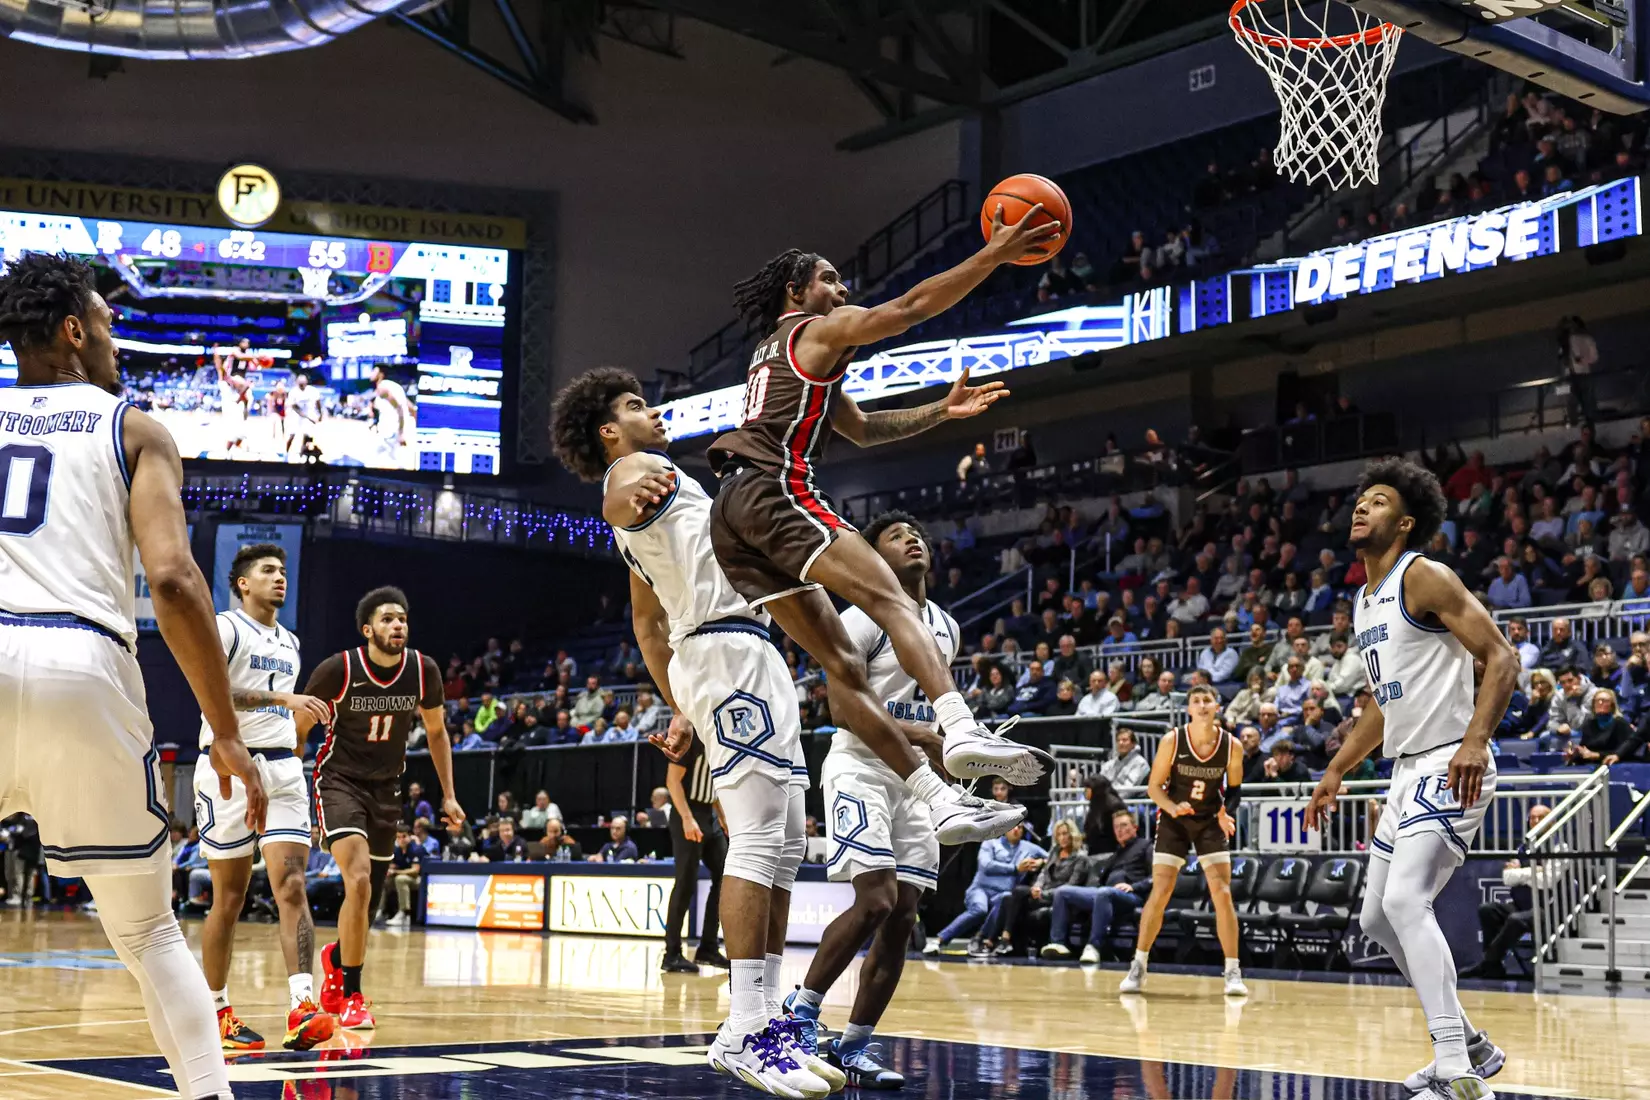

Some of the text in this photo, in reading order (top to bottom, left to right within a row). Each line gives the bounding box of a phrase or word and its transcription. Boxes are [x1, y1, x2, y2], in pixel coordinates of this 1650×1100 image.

[26, 184, 213, 219] UNIVERSITY
[141, 228, 182, 258] 48
[420, 219, 505, 241] ISLAND
[218, 238, 266, 261] 6:42
[308, 240, 347, 269] 55
[367, 242, 394, 274] B
[1294, 205, 1542, 303] DEFENSE
[250, 655, 293, 676] RHODE
[1365, 648, 1381, 685] 10
[350, 695, 417, 711] BROWN
[887, 701, 938, 723] ISLAN
[366, 714, 394, 741] 11
[1190, 780, 1206, 801] 2
[1266, 806, 1308, 844] 111
